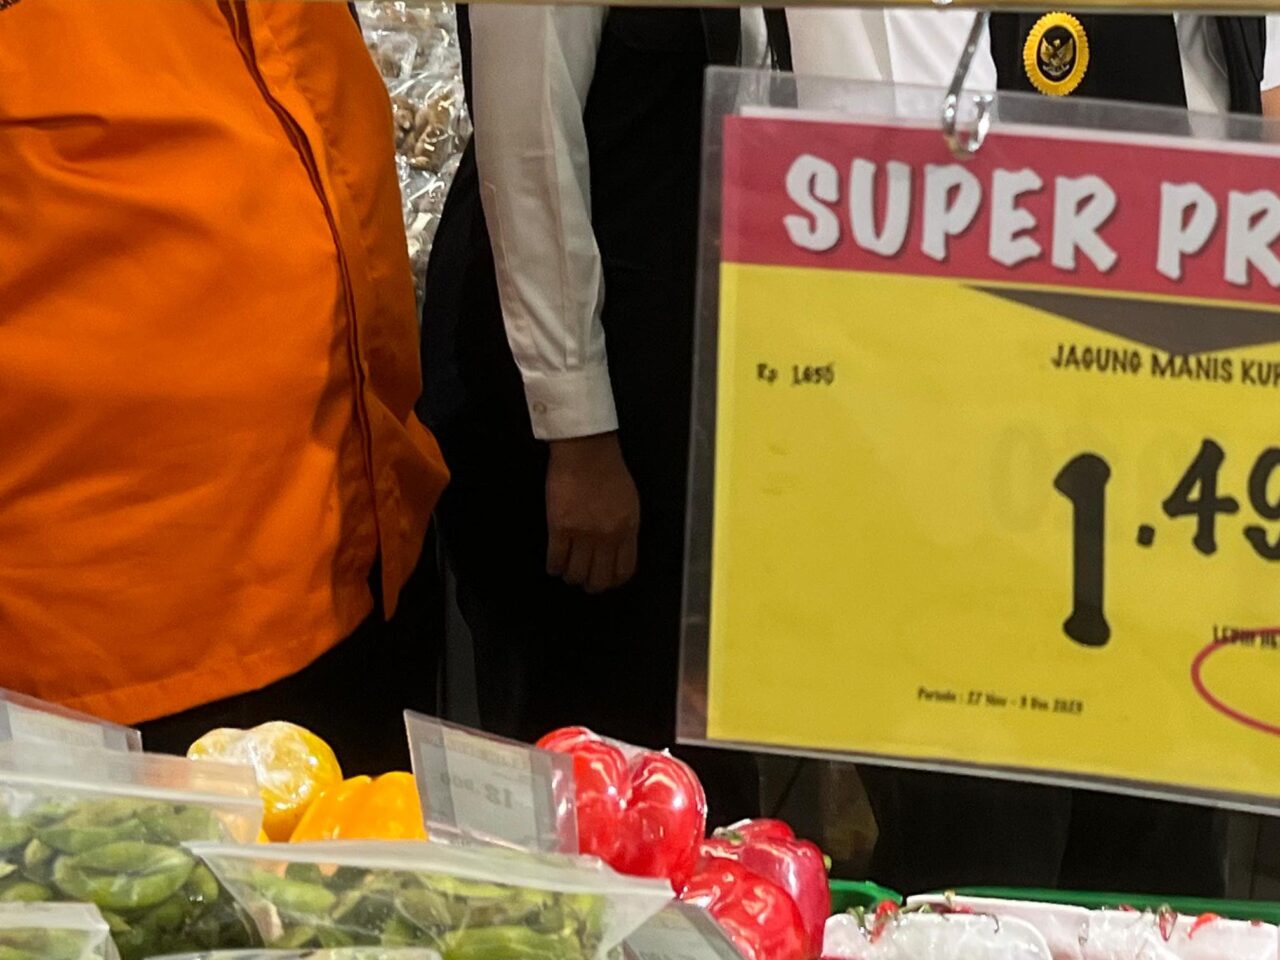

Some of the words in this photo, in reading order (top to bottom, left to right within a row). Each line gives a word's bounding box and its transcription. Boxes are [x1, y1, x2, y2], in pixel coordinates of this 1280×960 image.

[784, 154, 1119, 274] SUPER
[1052, 343, 1142, 374] JAGUNG
[1151, 353, 1233, 383] MANIS
